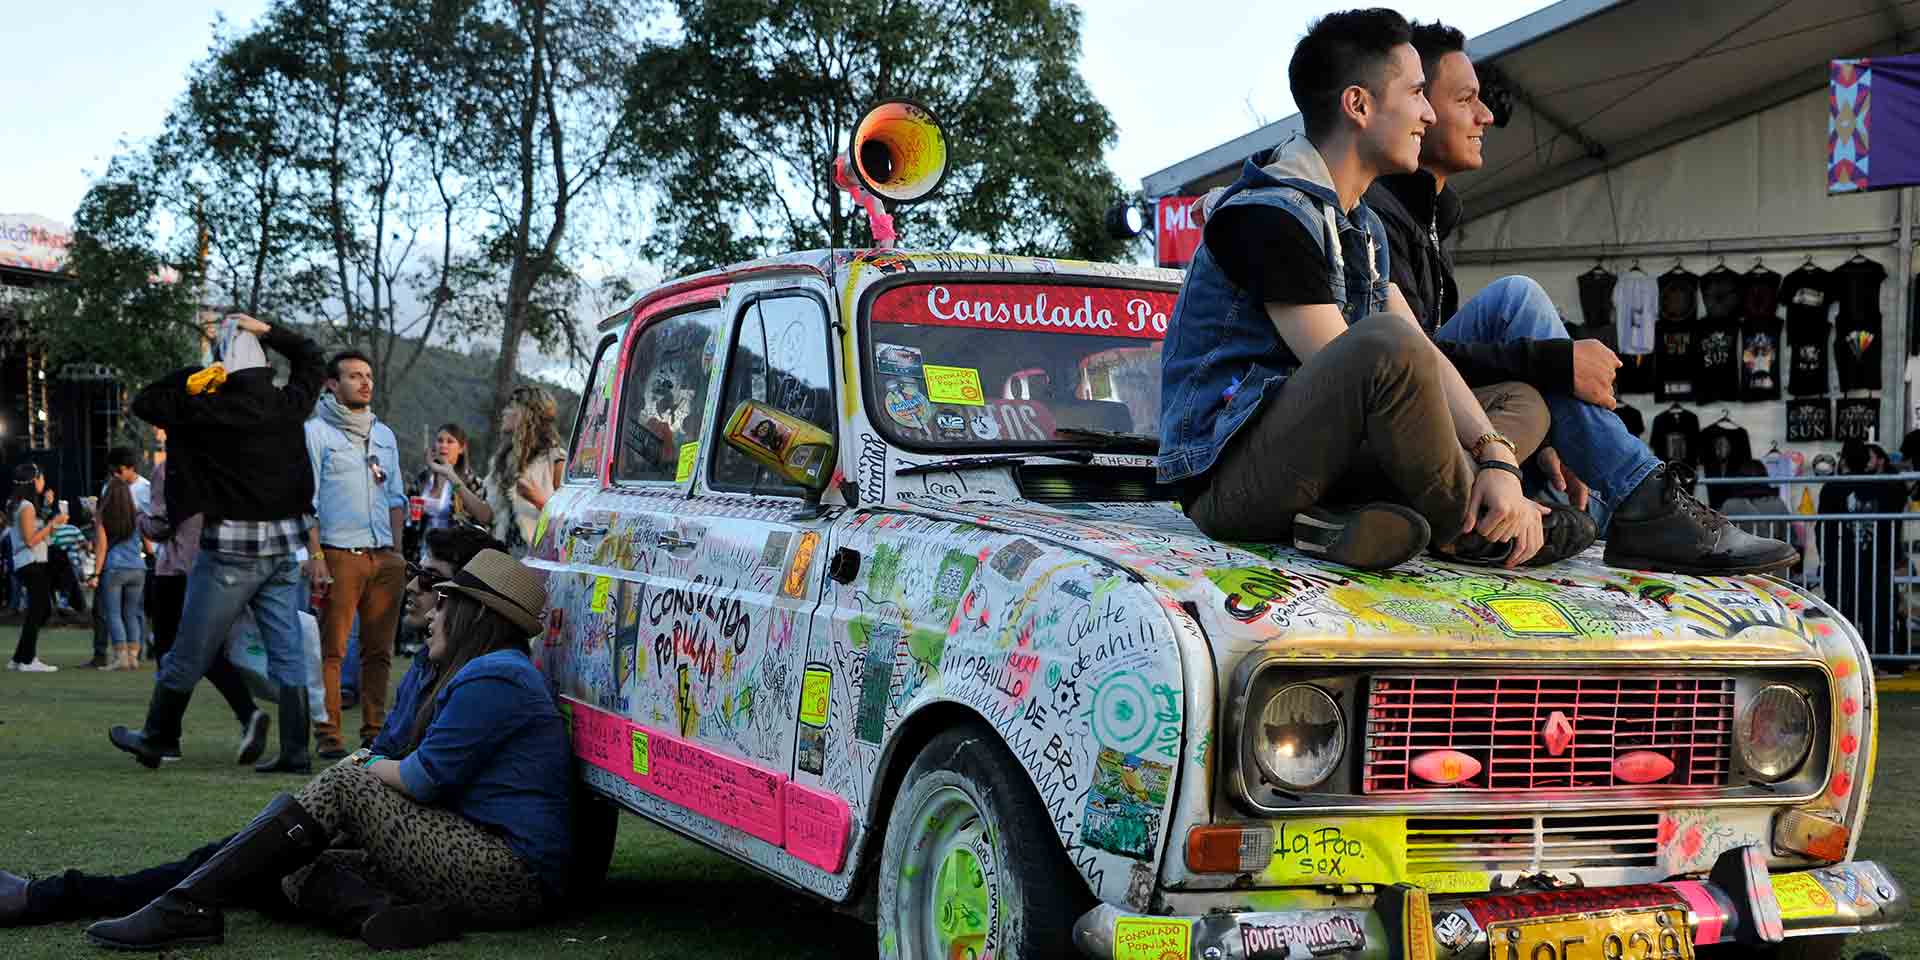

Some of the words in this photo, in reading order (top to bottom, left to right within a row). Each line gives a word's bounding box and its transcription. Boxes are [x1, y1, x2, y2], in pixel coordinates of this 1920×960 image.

[927, 285, 1118, 329] Consulado
[1790, 425, 1825, 438] SUN
[650, 587, 750, 655] CONSULADO
[1024, 696, 1048, 731] DE
[1119, 926, 1180, 943] CONSULADO
